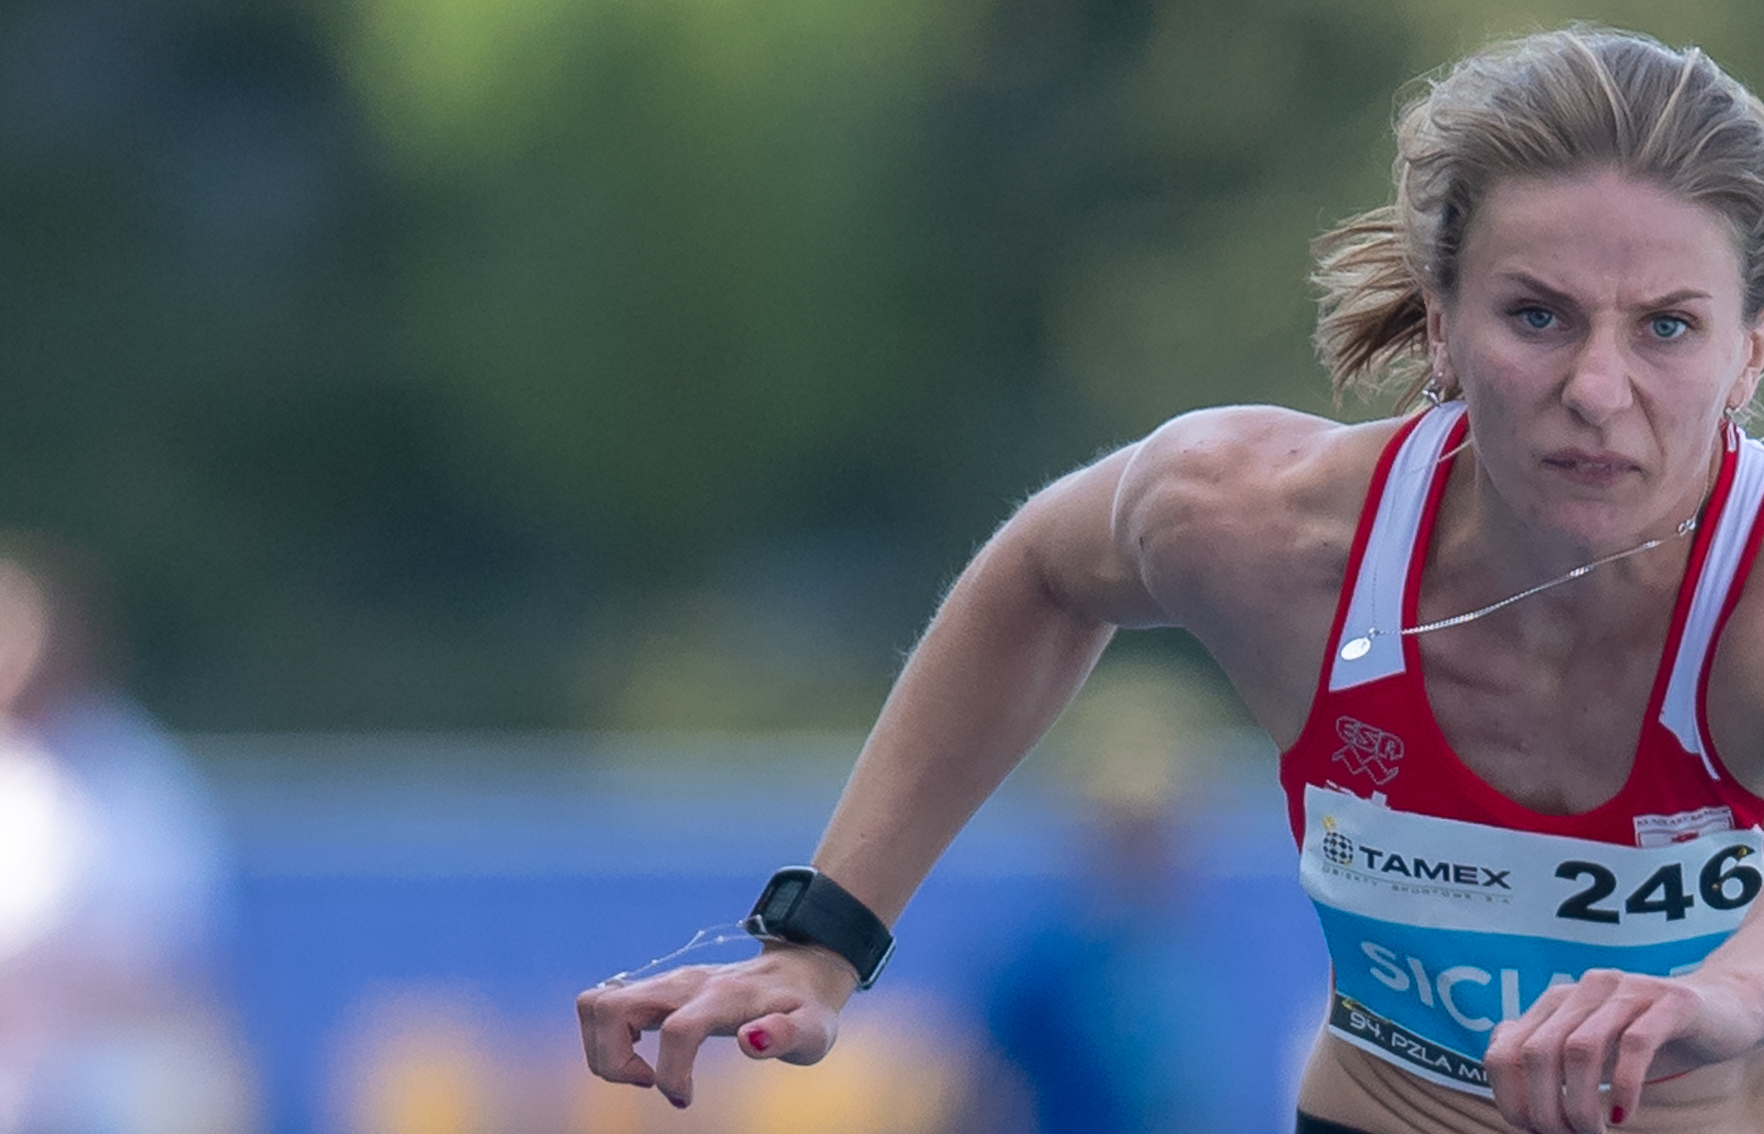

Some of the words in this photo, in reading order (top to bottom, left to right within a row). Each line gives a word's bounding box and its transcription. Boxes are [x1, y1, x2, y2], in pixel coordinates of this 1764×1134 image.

[1358, 845, 1512, 890] TAMEX
[1554, 844, 1763, 925] 246
[1350, 1011, 1386, 1042] 94.
[1391, 1031, 1452, 1073] PZLA
